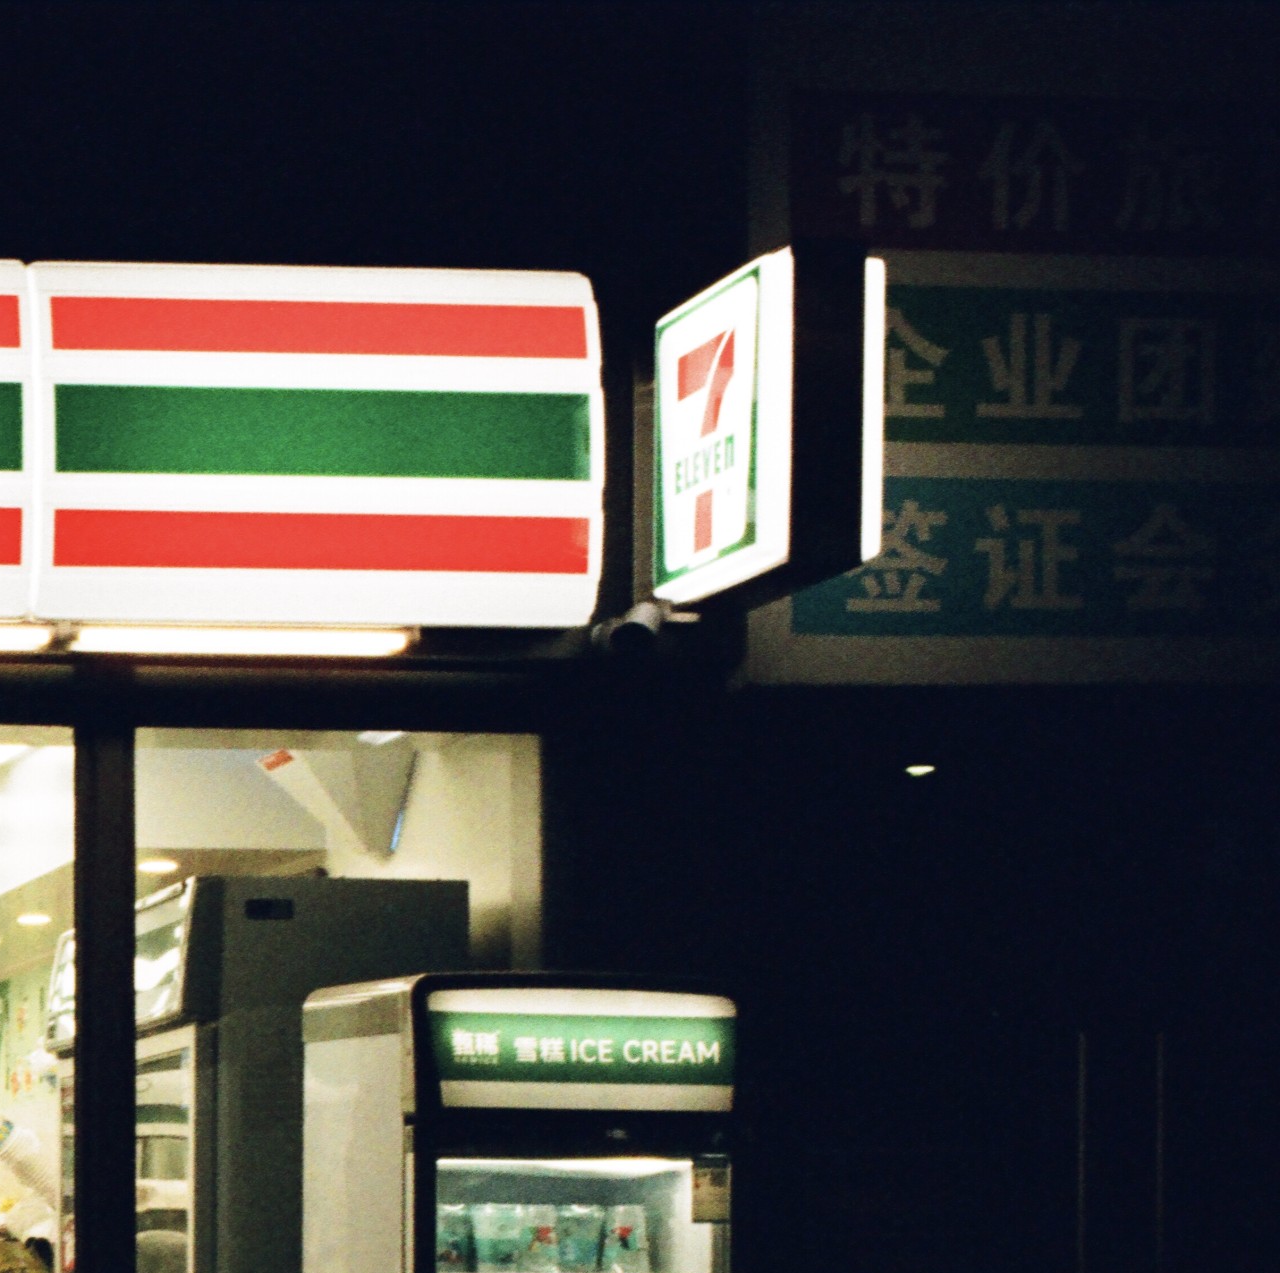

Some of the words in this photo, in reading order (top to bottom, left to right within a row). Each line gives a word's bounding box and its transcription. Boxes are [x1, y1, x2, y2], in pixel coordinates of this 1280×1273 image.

[677, 327, 735, 553] 7
[571, 1038, 614, 1063] ICE
[623, 1039, 721, 1065] CREAM
